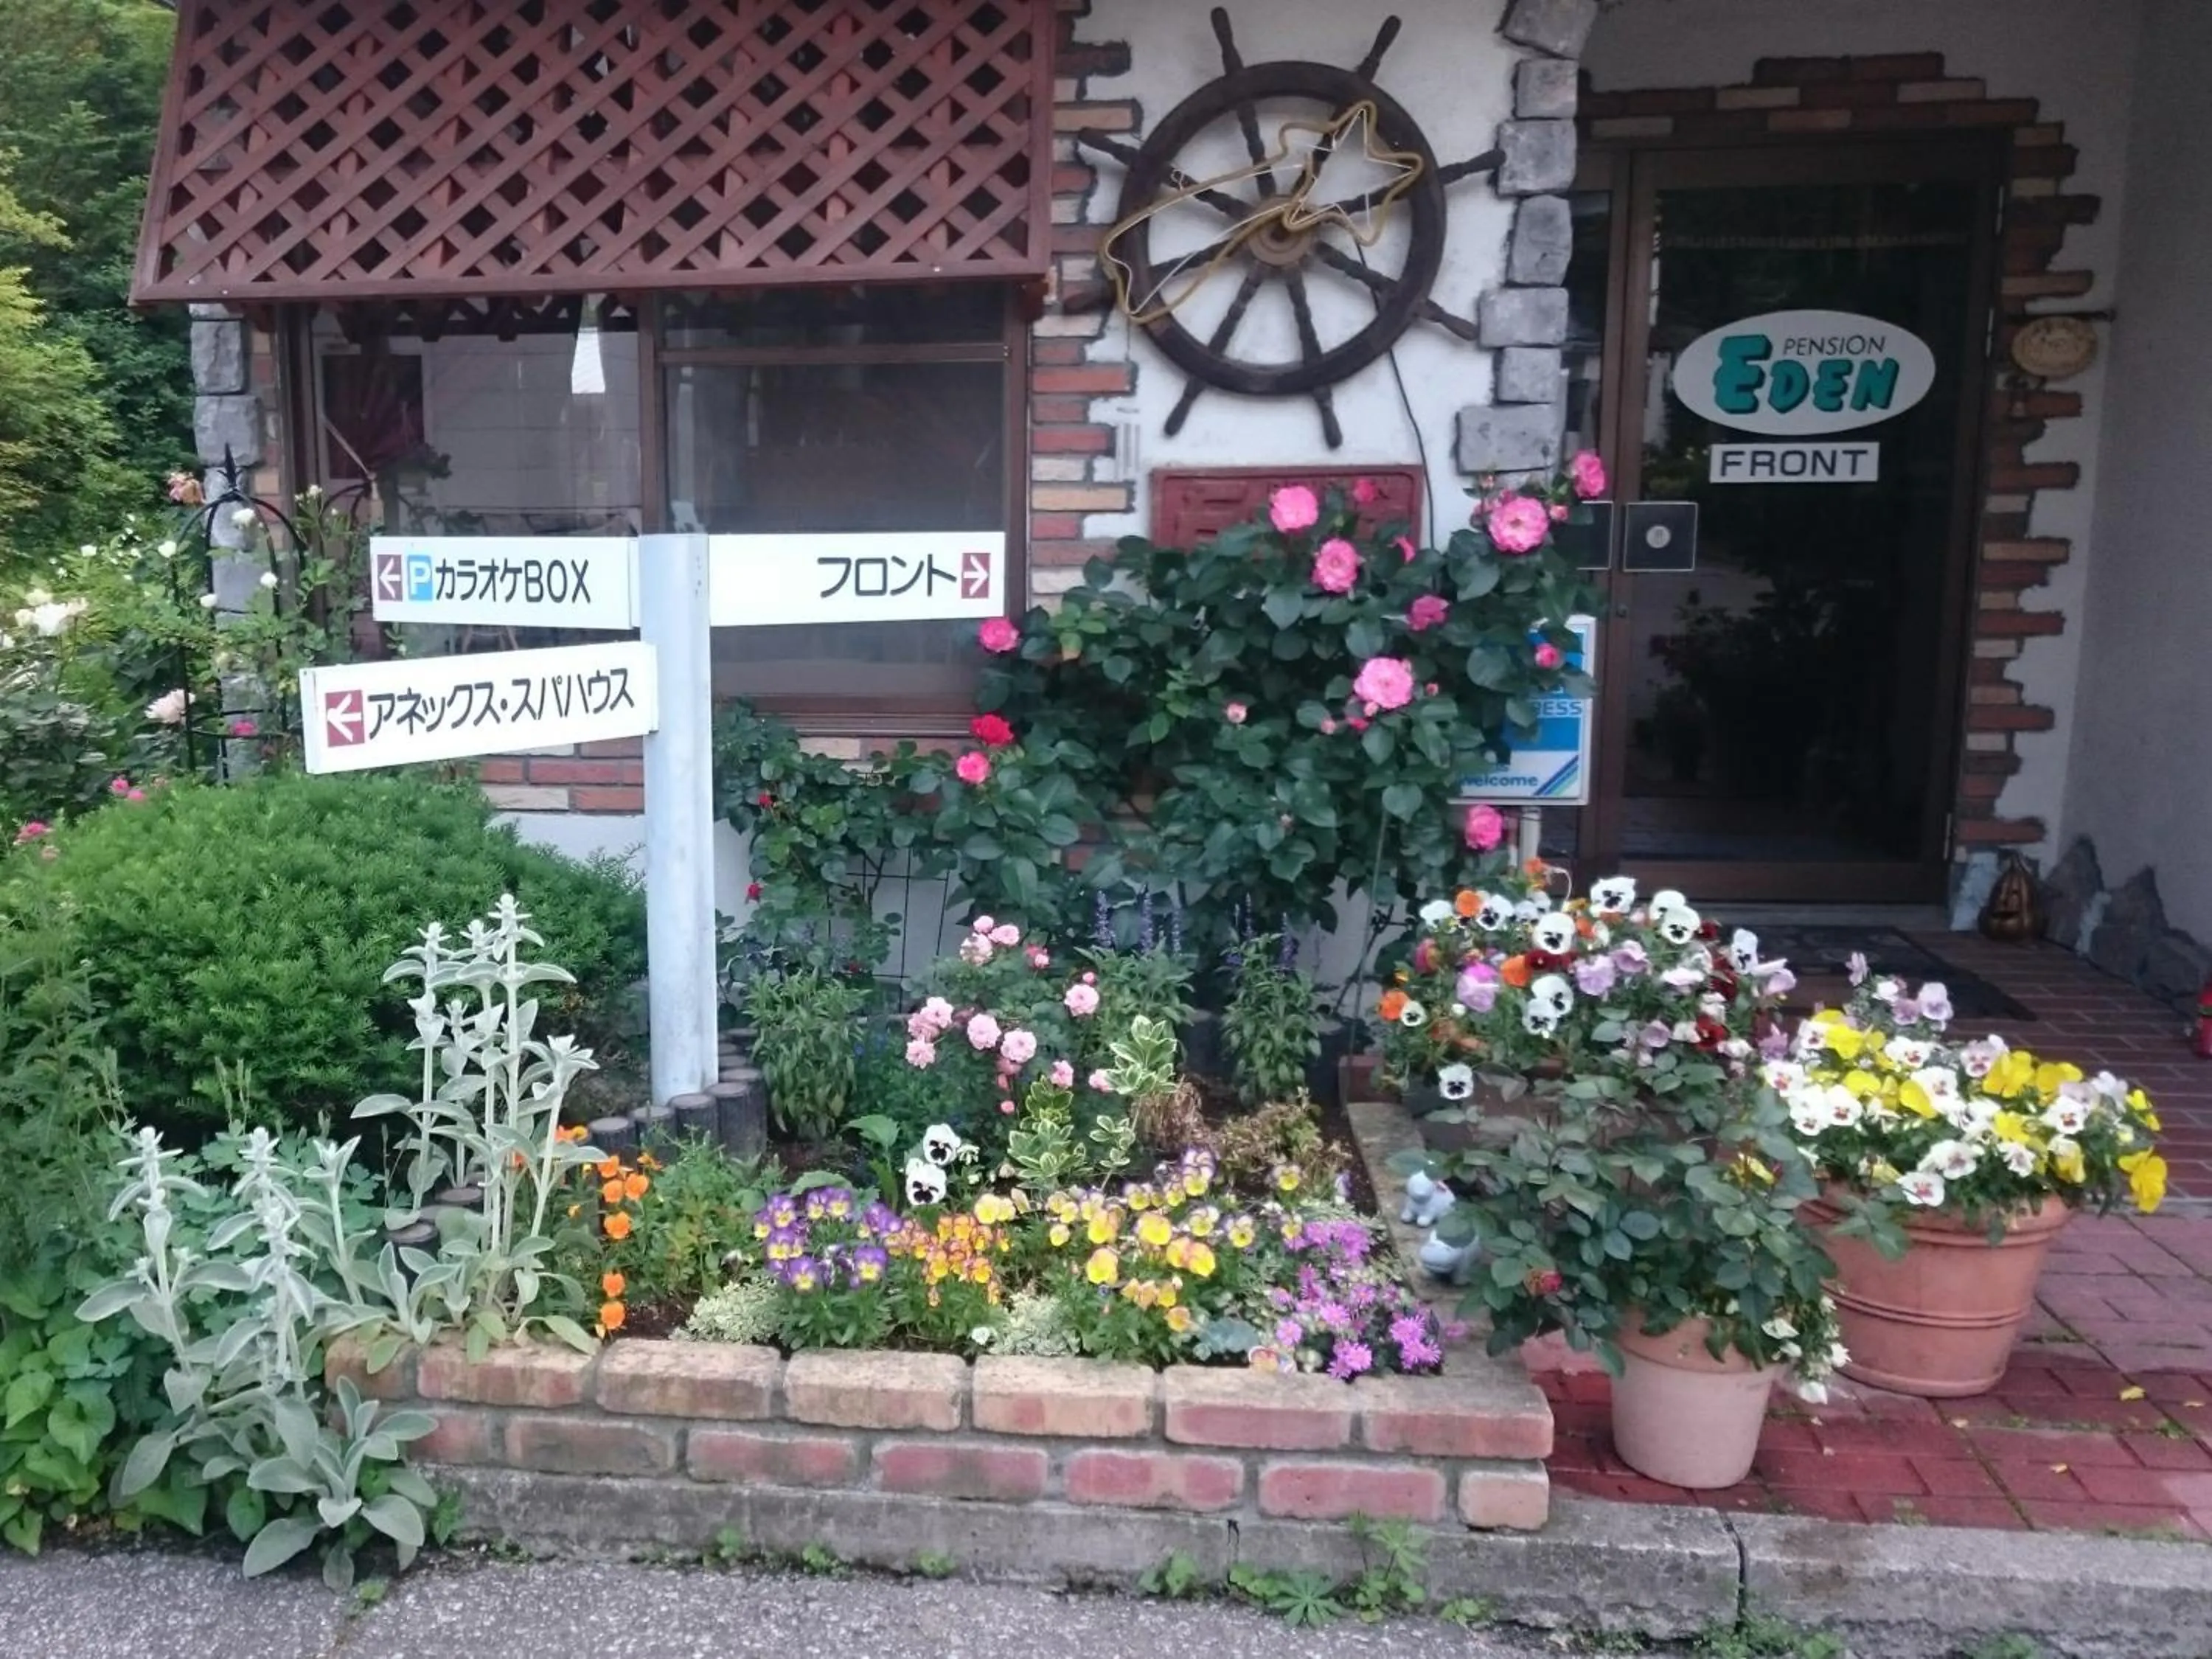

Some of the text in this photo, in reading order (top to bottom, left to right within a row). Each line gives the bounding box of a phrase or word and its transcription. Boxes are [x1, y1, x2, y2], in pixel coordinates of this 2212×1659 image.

[1782, 334, 1887, 356] PENSION
[1713, 334, 1900, 414] EDEN
[1719, 450, 1868, 476] FRONT
[411, 558, 591, 603] P カラオケBOX
[817, 554, 956, 598] フロント
[367, 667, 636, 740] アネックス・スパハウス
